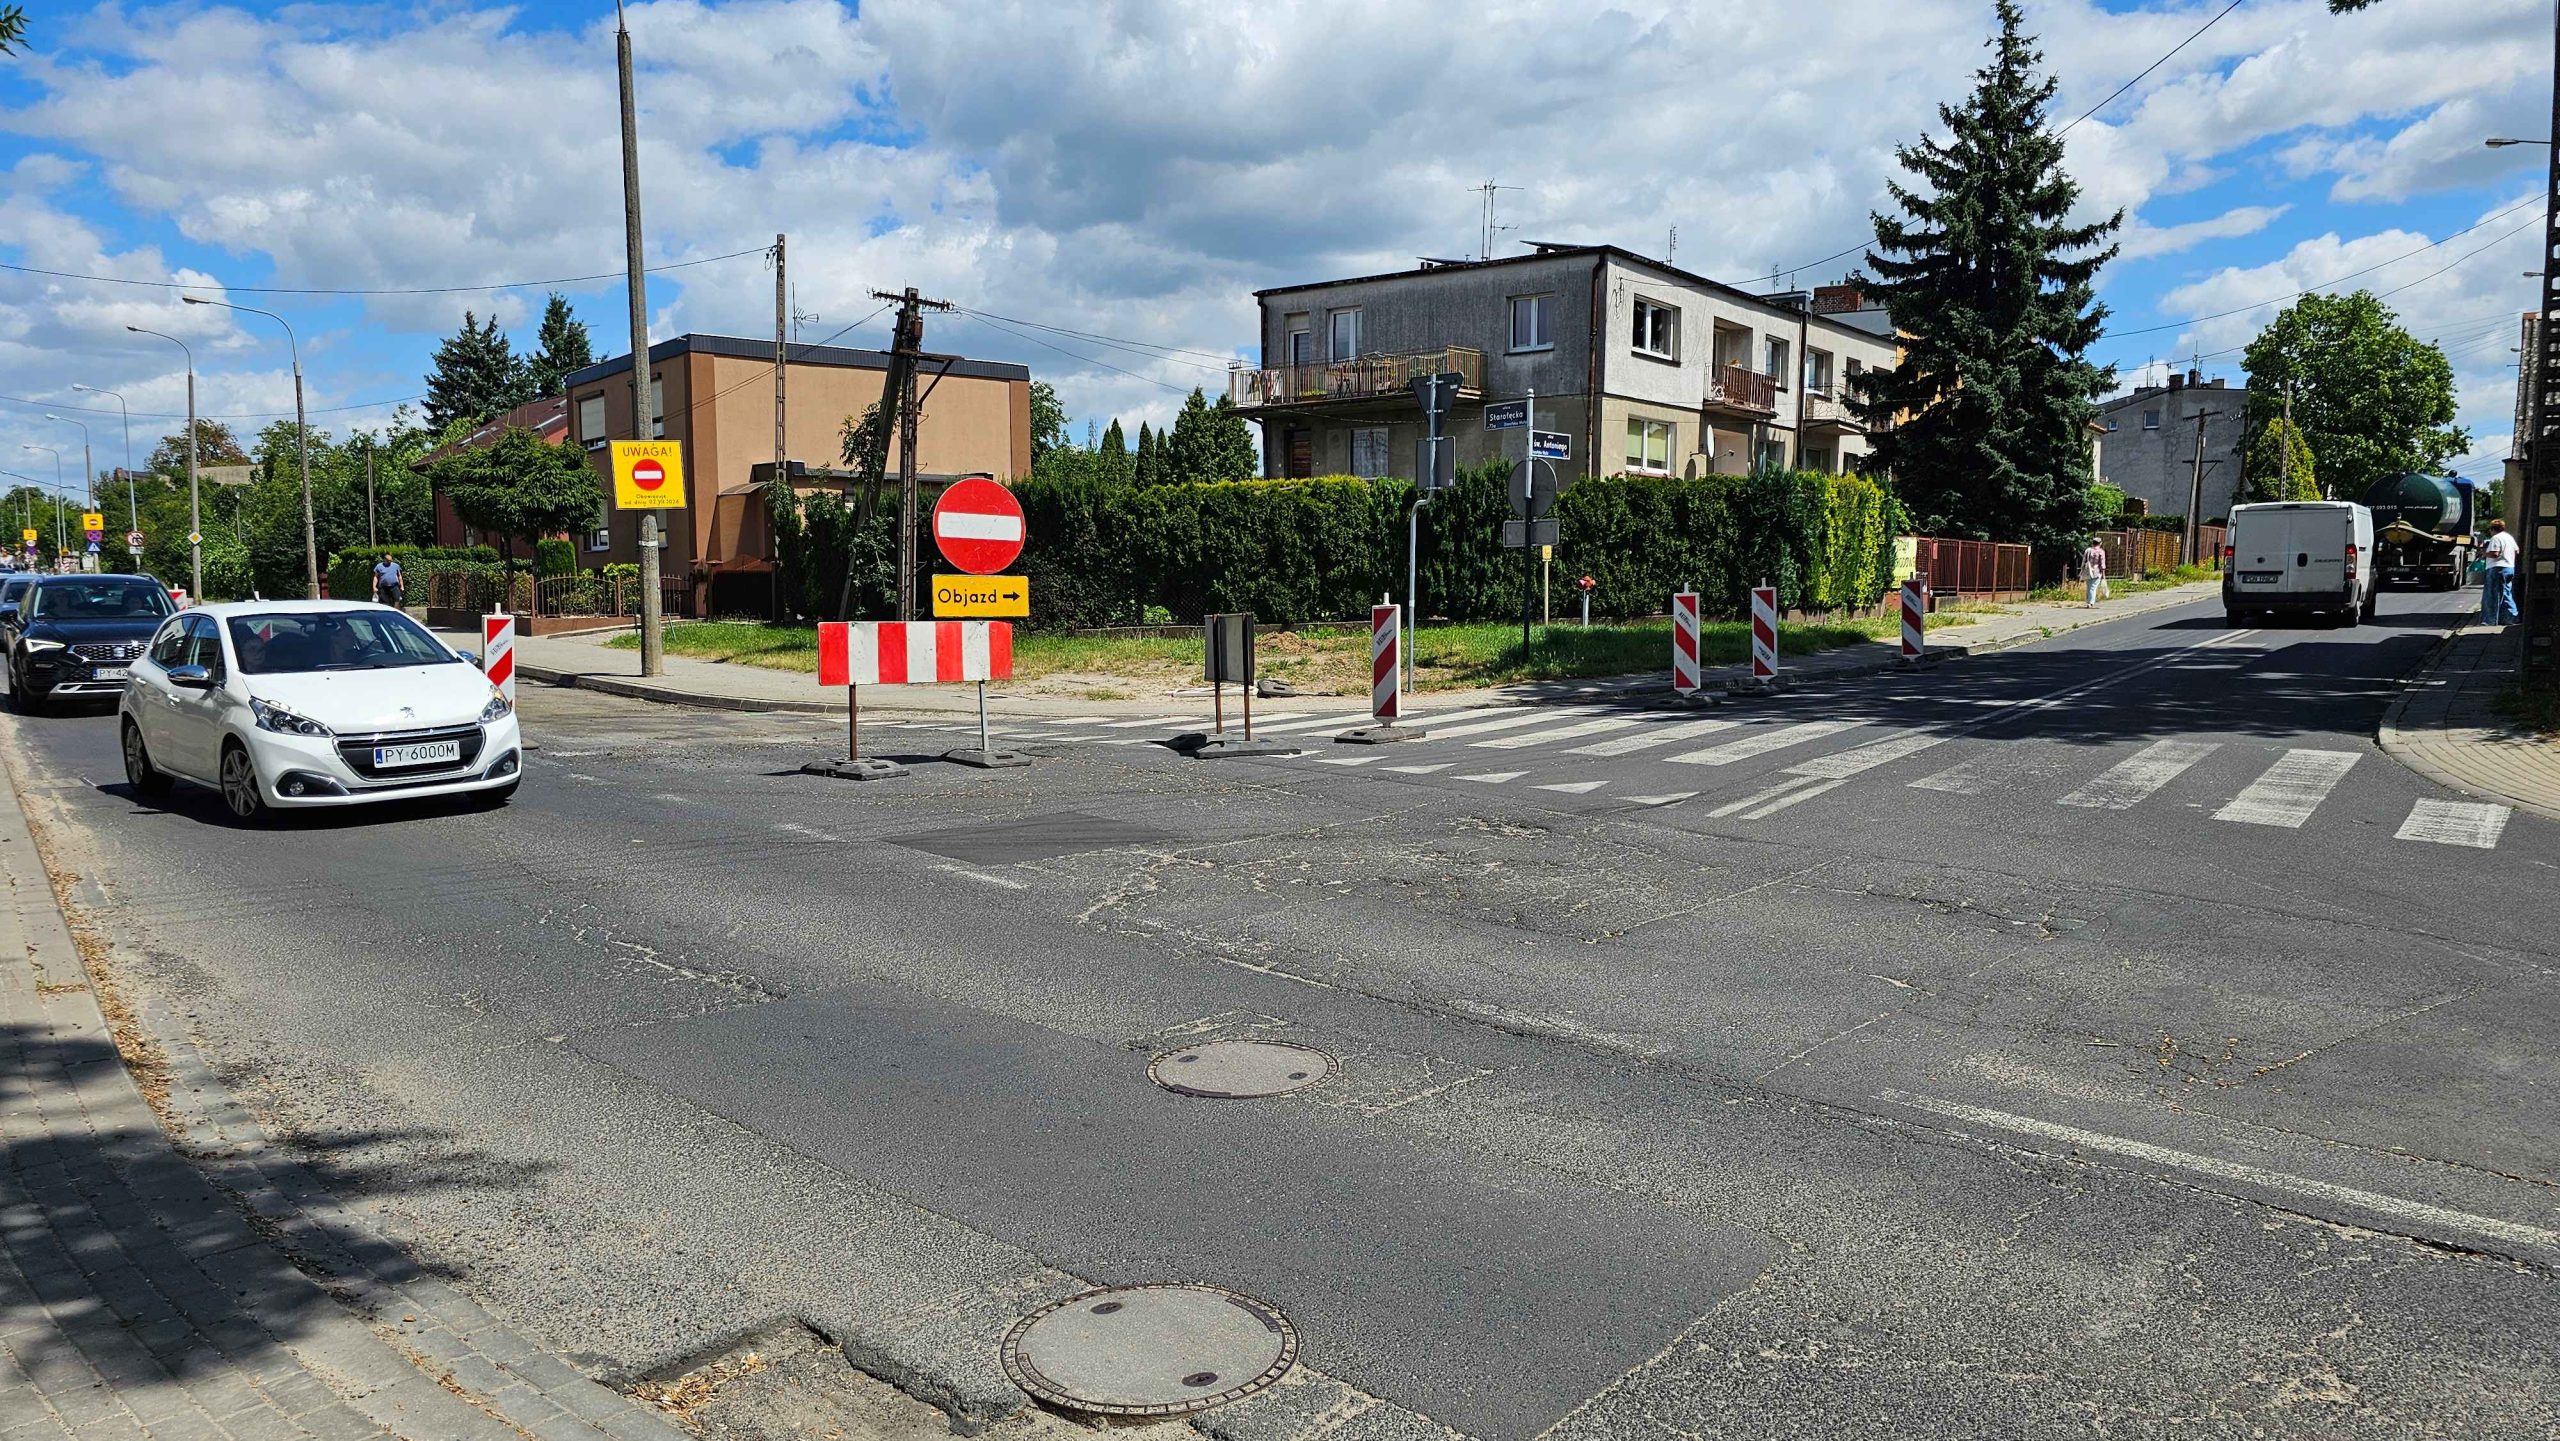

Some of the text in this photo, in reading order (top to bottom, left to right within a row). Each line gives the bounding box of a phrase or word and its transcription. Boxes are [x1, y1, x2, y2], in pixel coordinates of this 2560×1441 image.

[622, 446, 673, 457] UWAGA!
[1543, 440, 1567, 452] Antoniego
[937, 588, 998, 607] Objazd
[385, 743, 456, 763] PY 6000M
